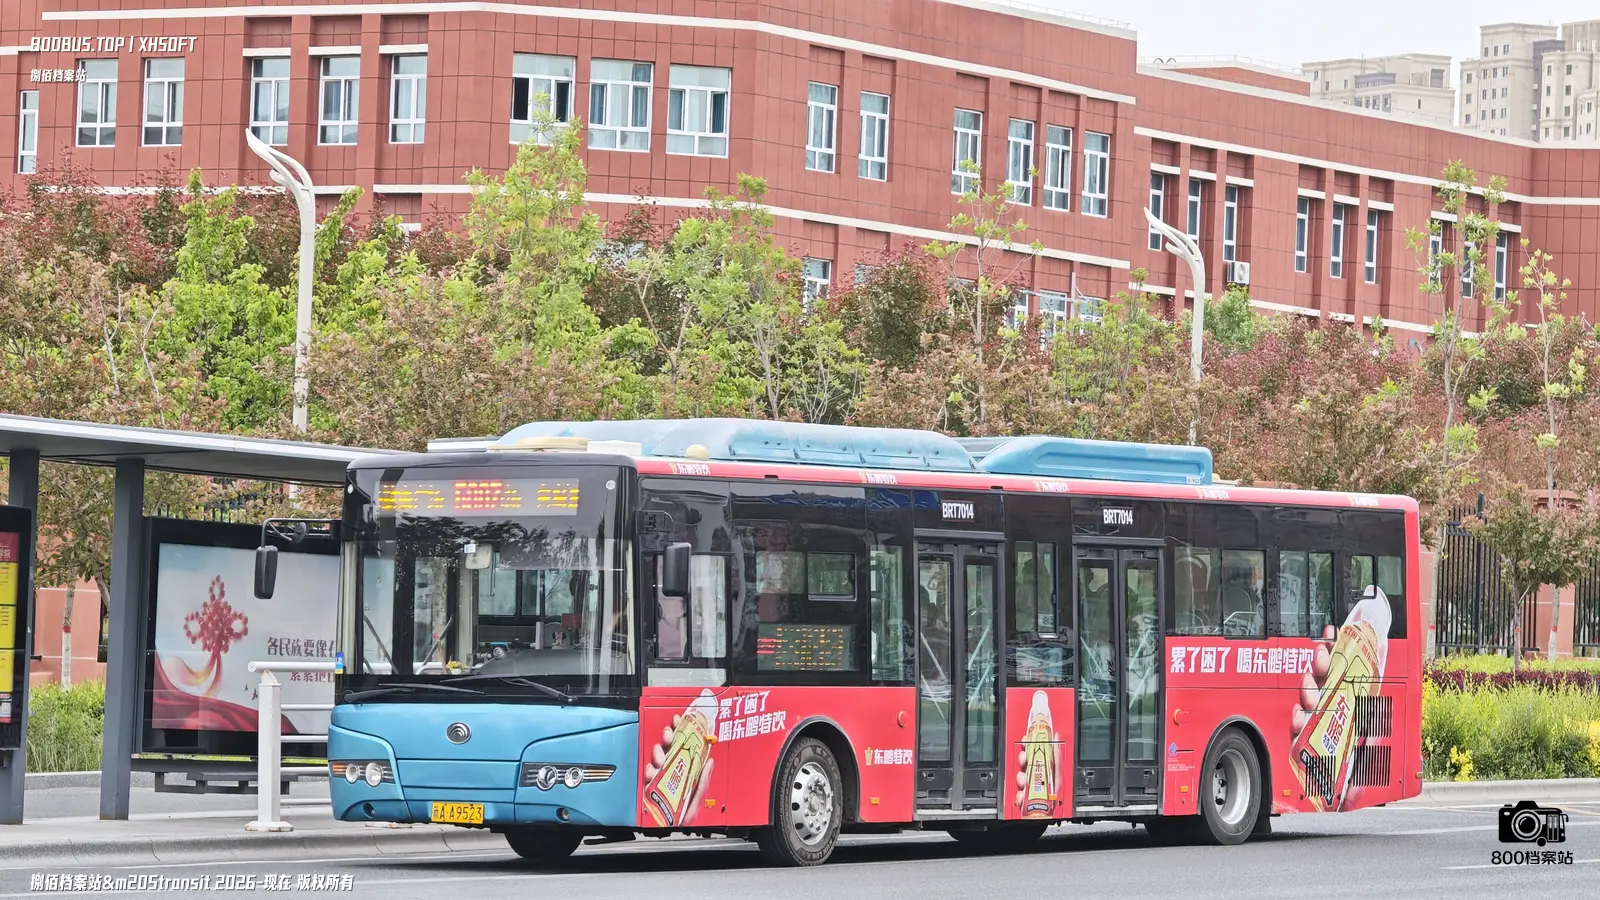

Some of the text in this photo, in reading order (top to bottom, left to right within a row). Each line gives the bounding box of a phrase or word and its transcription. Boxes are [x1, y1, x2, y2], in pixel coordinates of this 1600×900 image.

[942, 502, 974, 519] BRT7014
[1103, 509, 1134, 525] BRT7014
[1170, 646, 1314, 674] 累了困了 喝东鹏特饮
[718, 690, 770, 720] 累了困了
[718, 710, 787, 743] 喝东鹏特饮
[874, 748, 913, 765] 东鹏特饮
